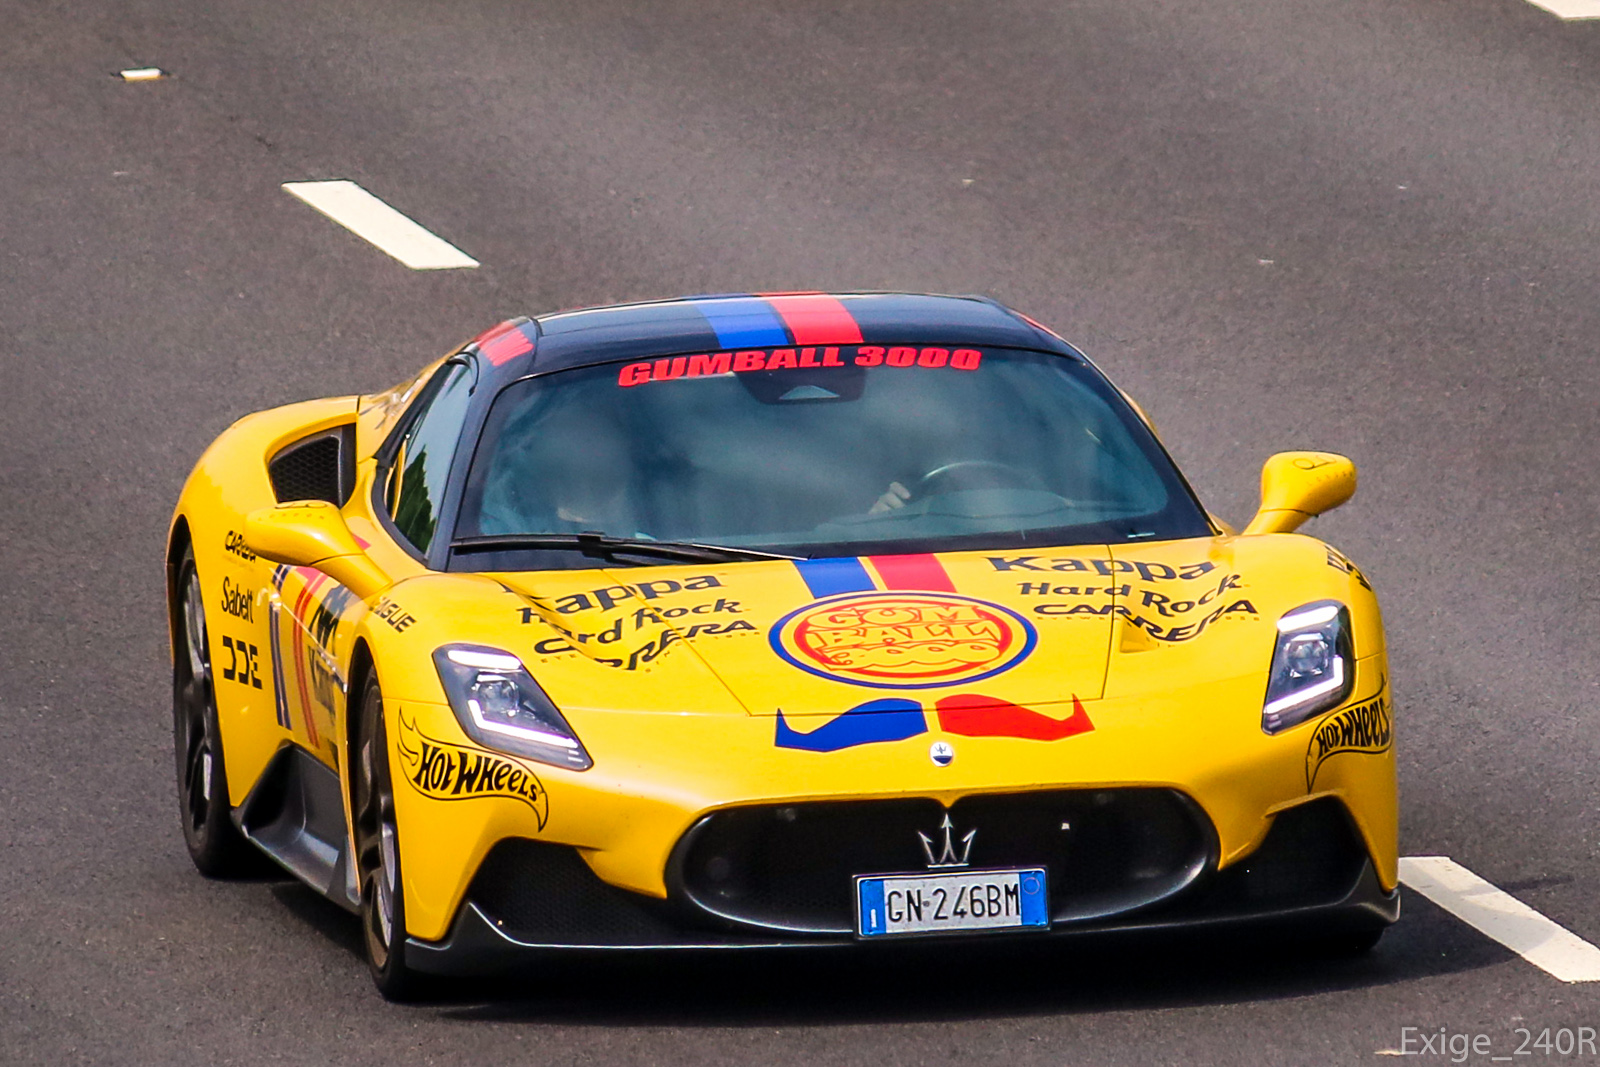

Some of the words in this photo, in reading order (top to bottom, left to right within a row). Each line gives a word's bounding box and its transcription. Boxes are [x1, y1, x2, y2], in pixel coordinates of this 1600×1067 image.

[618, 346, 844, 387] GUMBALL
[855, 346, 982, 371] 3000
[985, 557, 1217, 583] Kappa
[221, 575, 254, 624] Sabelt
[630, 598, 743, 632] Rock
[1018, 582, 1132, 597] Hard
[1139, 574, 1241, 617] Rock
[1033, 600, 1258, 642] CARRERA
